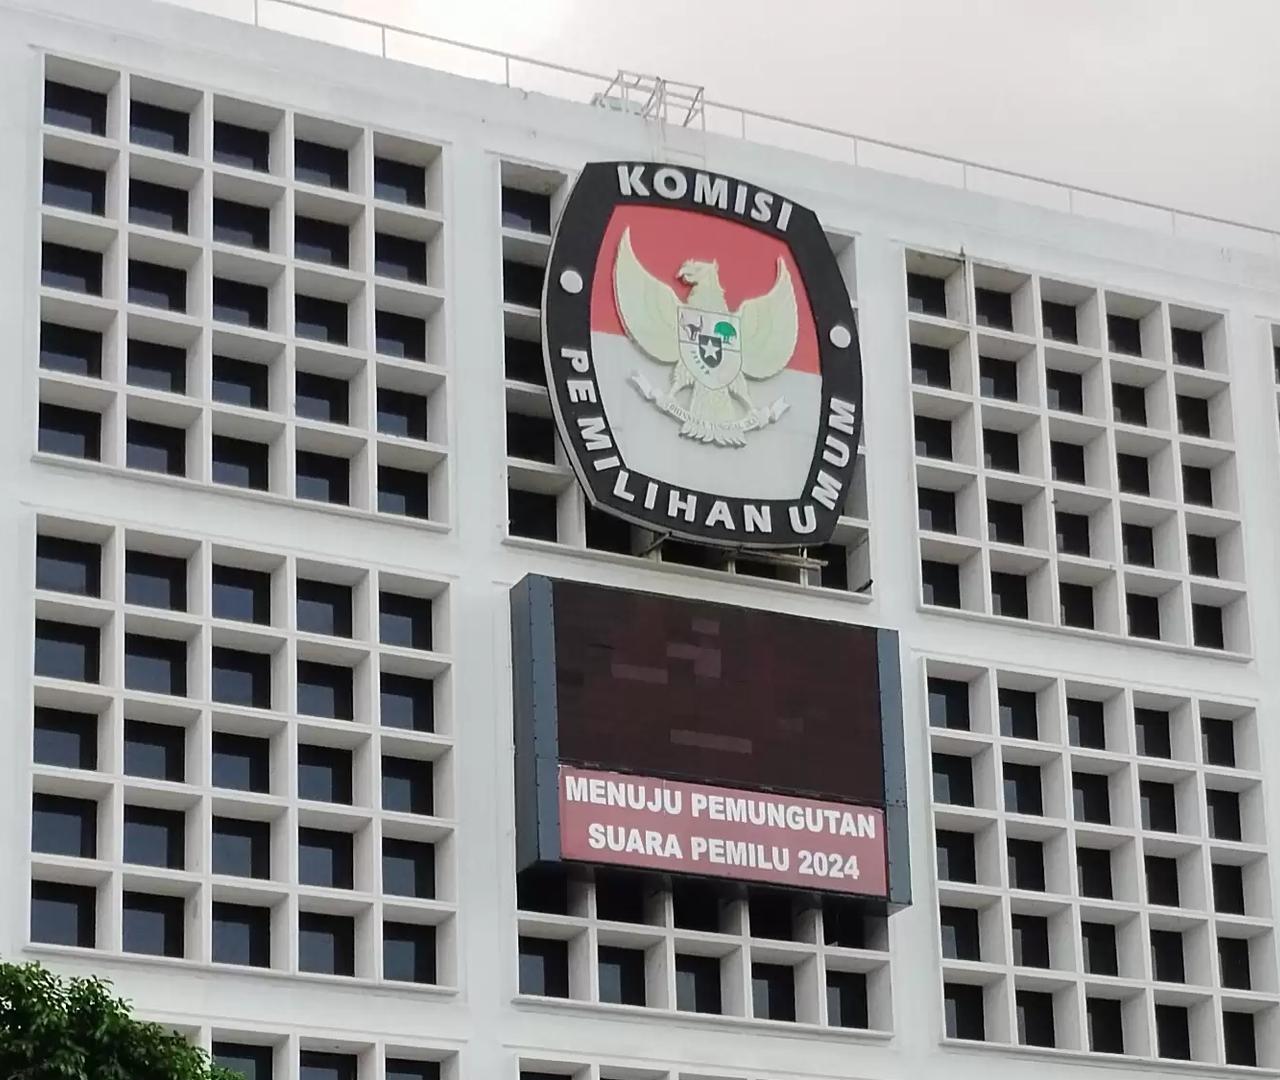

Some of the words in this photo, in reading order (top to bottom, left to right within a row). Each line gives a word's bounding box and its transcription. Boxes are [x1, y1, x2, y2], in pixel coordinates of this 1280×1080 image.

[617, 165, 793, 232] KOMISI
[561, 347, 773, 534] PEMILIHAN
[788, 397, 856, 534] UMUM
[565, 776, 682, 815] MENUJU
[691, 792, 876, 839] PEMUNGUTAN
[588, 823, 683, 859] SUARA
[690, 837, 790, 872] PEMILU
[797, 850, 860, 880] 2024
